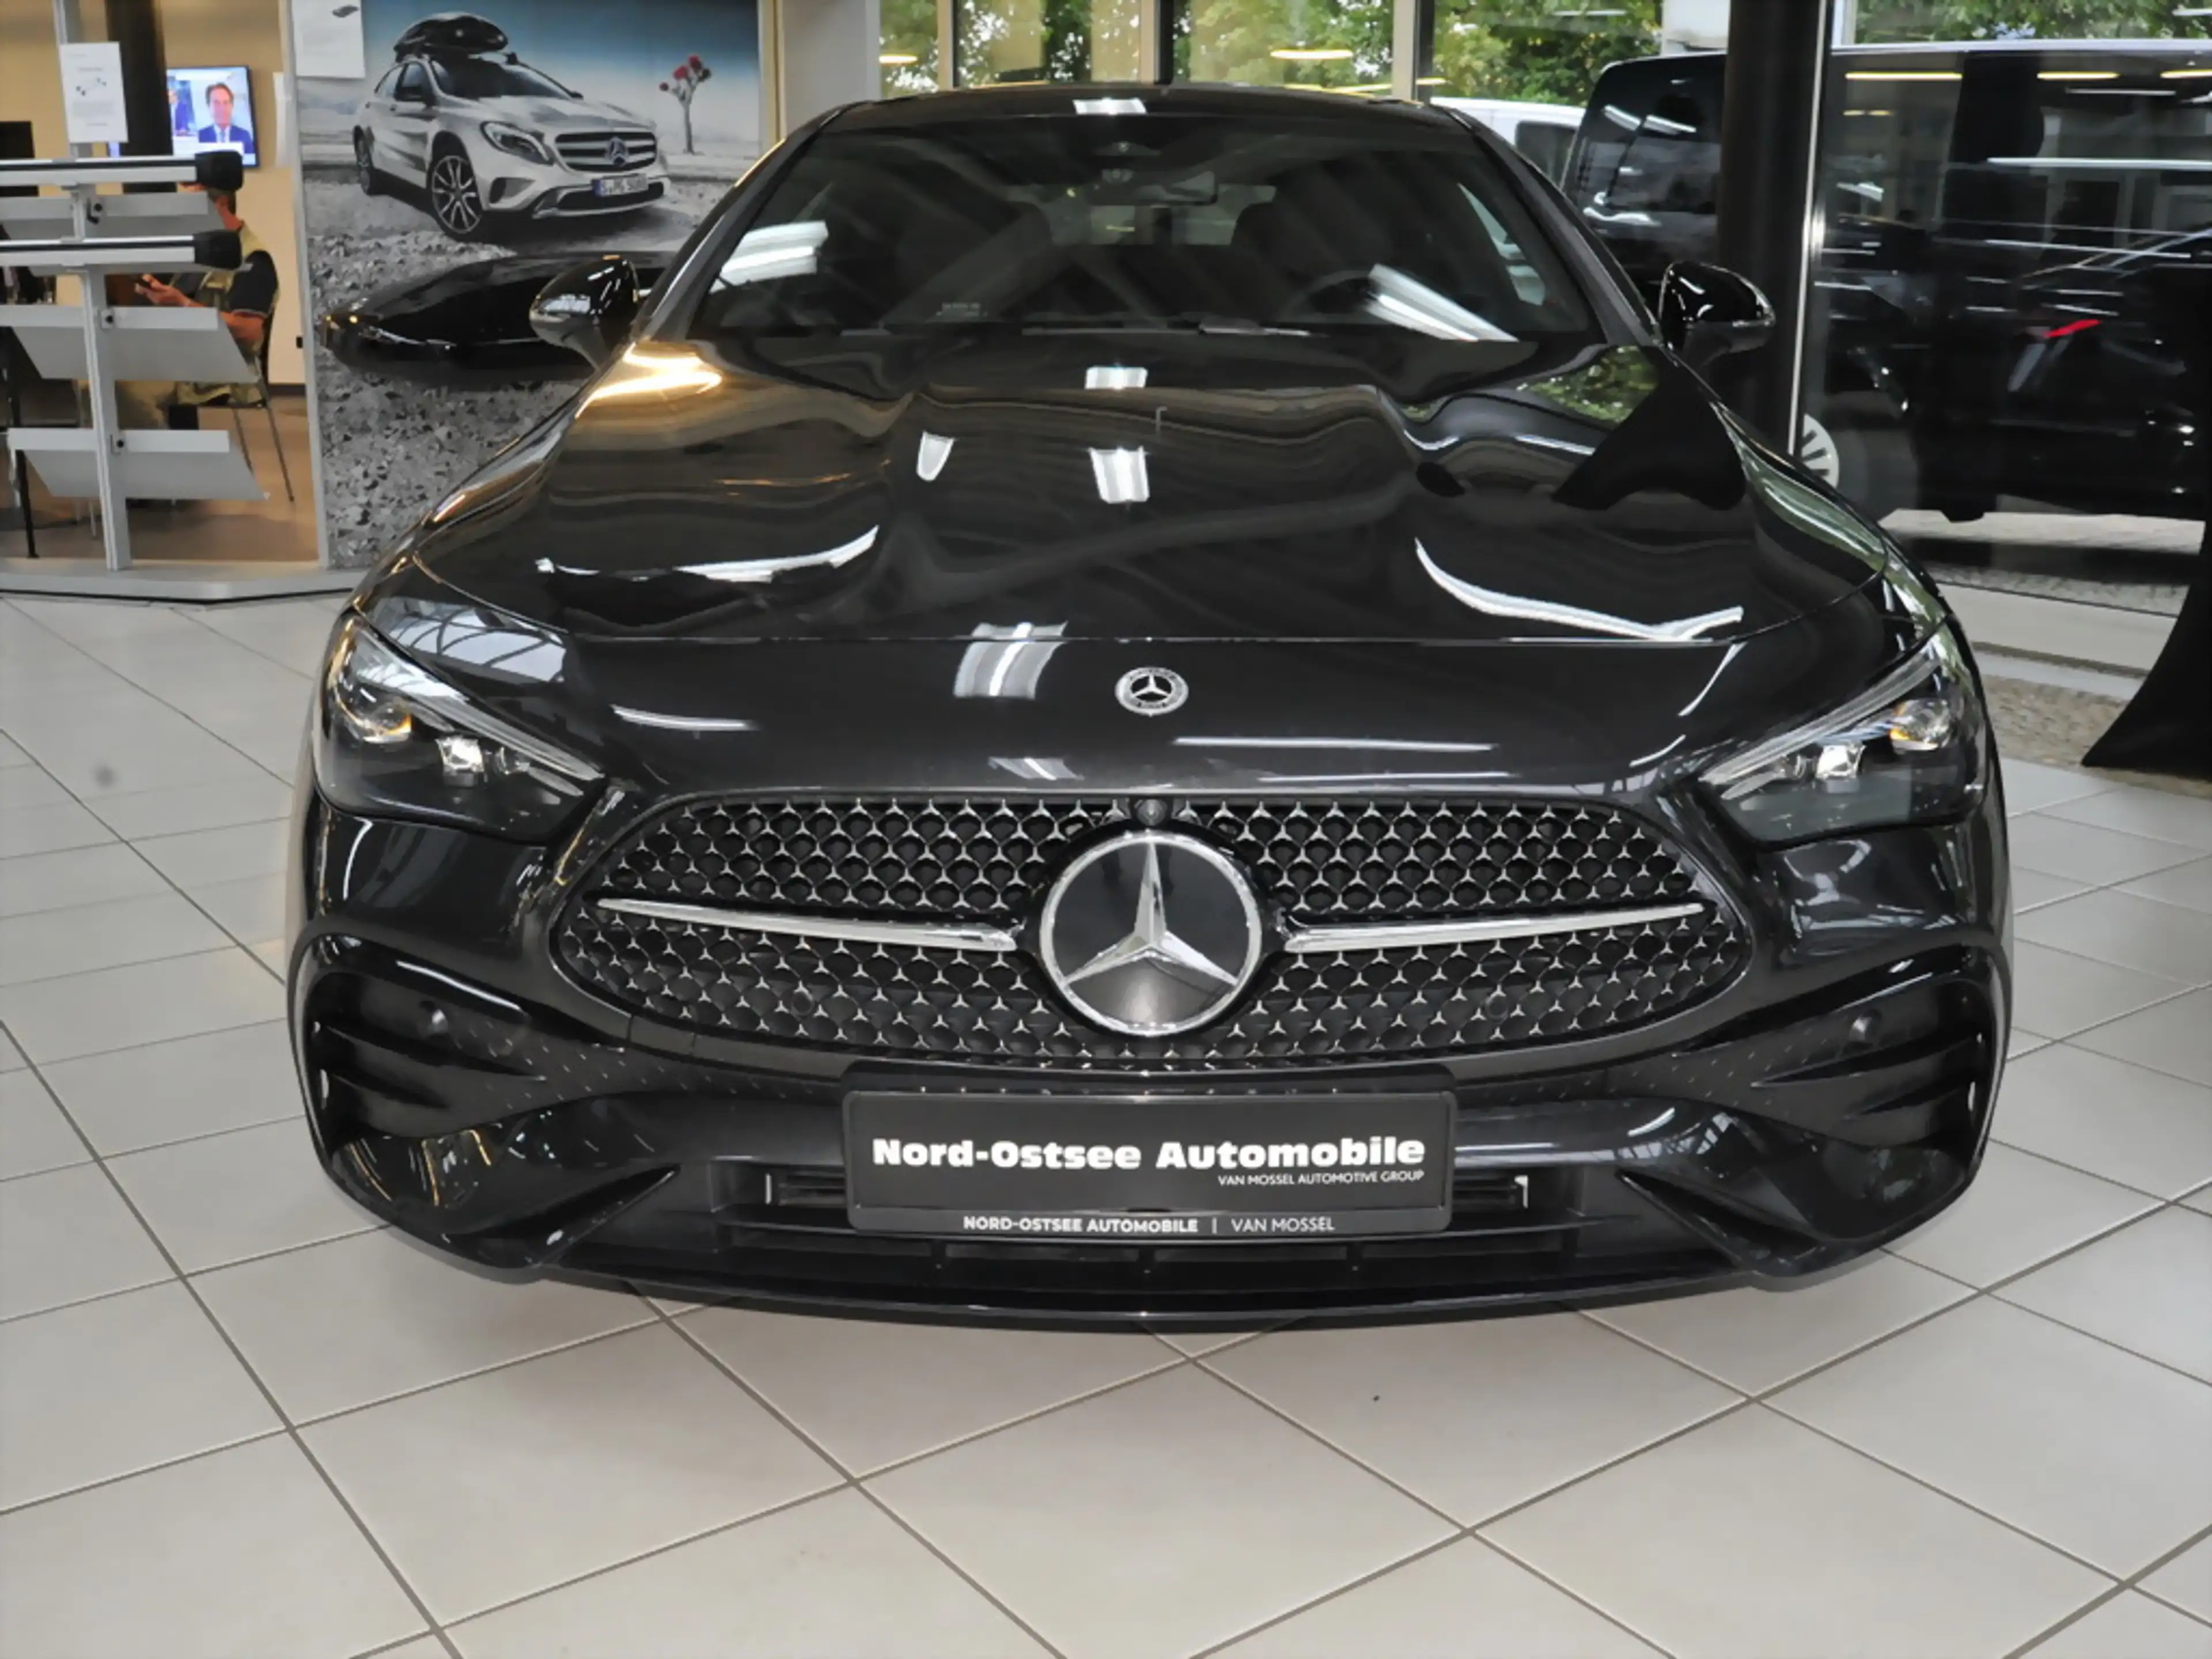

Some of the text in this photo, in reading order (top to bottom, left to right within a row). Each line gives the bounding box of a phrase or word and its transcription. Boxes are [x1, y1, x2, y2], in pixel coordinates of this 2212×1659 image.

[872, 1136, 1425, 1169] Nord-Ostsee Automobile
[1218, 1169, 1425, 1186] VAN MOSSEL AUTOMOTIVE GROUP
[963, 1216, 1335, 1233] NORD-OSTSEE AUTOMOBILE VAN MOSSEL
